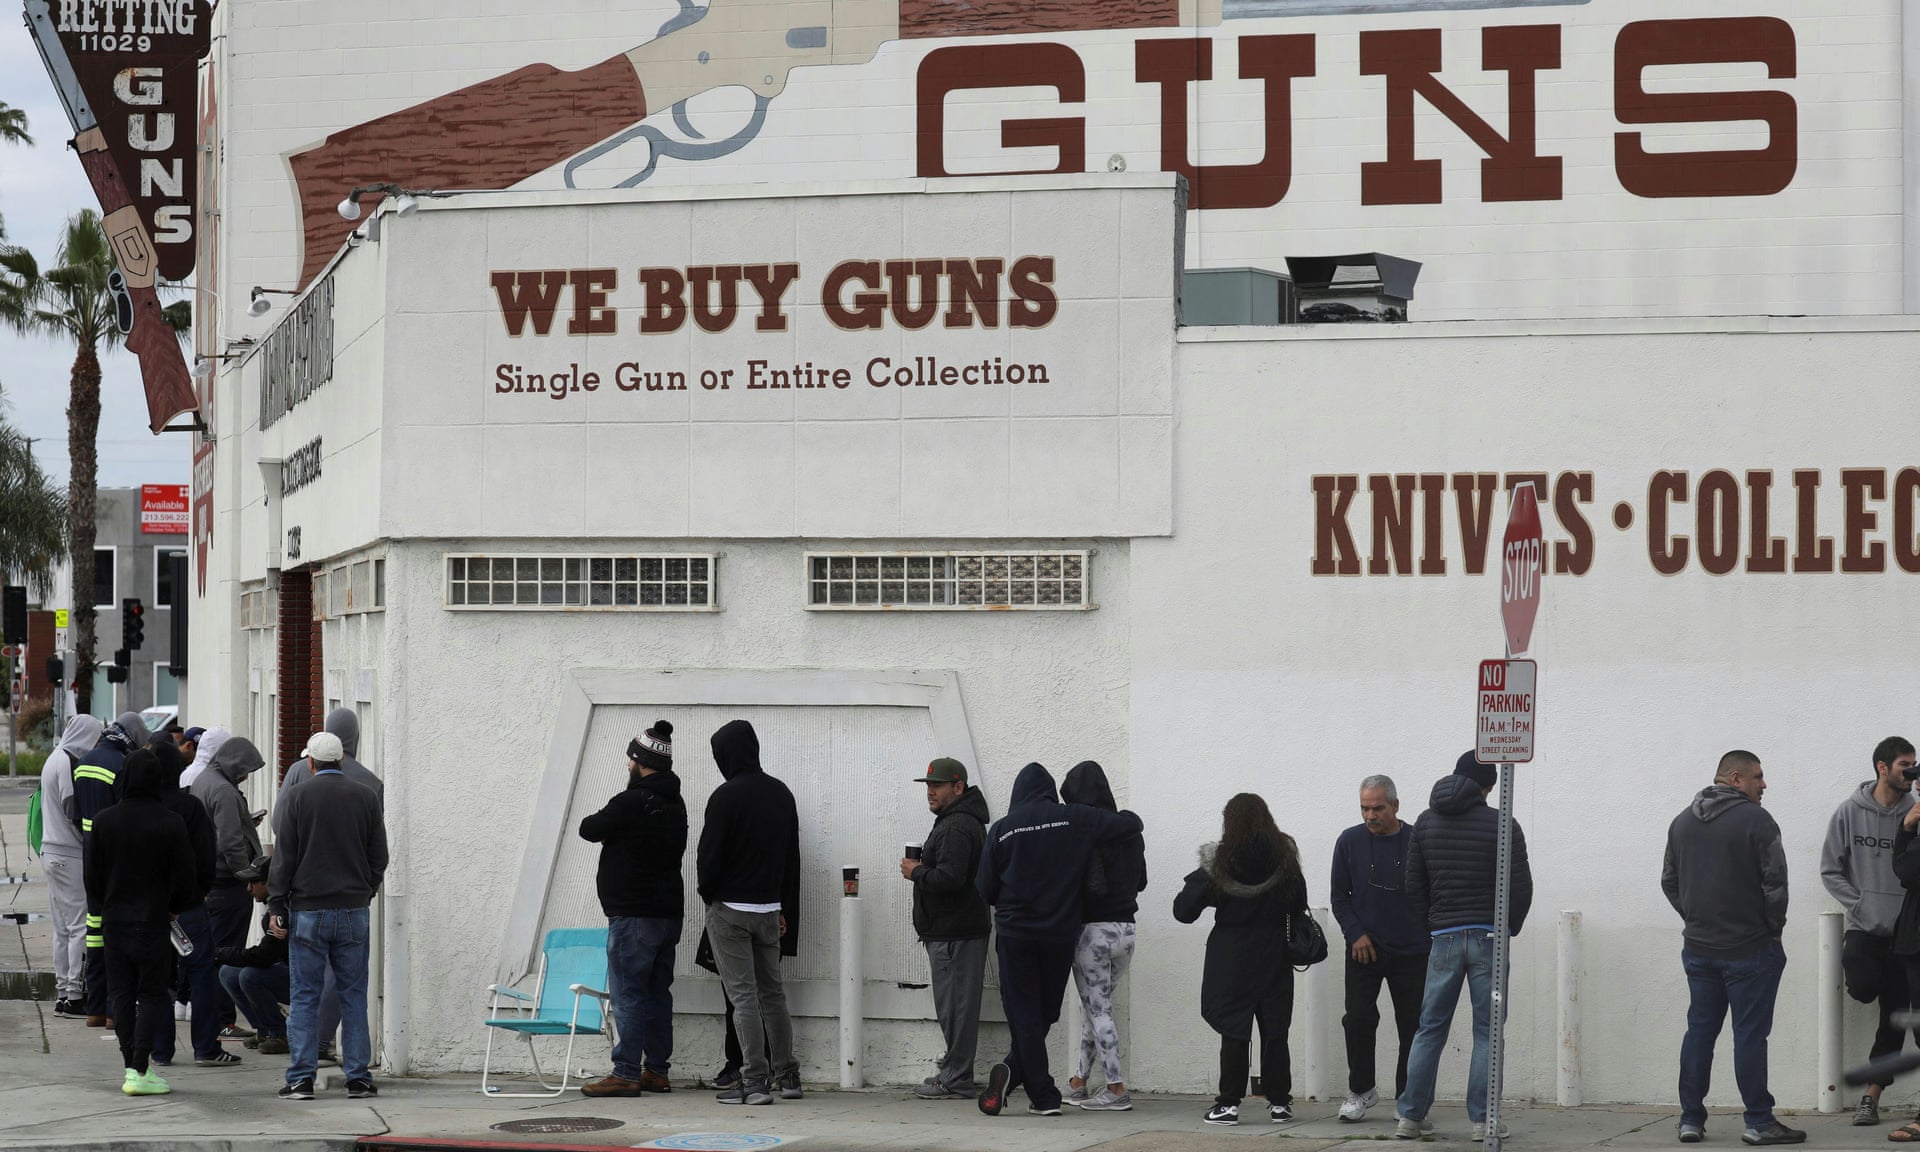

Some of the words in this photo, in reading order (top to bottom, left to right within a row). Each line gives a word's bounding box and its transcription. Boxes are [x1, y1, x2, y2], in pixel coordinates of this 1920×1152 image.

[58, 0, 198, 35] RETTING
[80, 34, 151, 53] 11029
[917, 17, 1798, 210] GUNS
[113, 67, 193, 244] GUNS
[490, 268, 617, 337] WE
[639, 262, 800, 334] BUY
[821, 256, 1058, 331] GUNS
[495, 363, 601, 400] Single
[615, 362, 688, 392] Gun
[699, 369, 735, 391] or
[747, 359, 852, 390] Entire
[866, 357, 1051, 387] Collection
[144, 500, 185, 510] Available
[1503, 538, 1539, 603] STOP
[1483, 664, 1502, 687] NO
[1482, 693, 1531, 713] PARKING
[1481, 746, 1501, 755] STREET
[1502, 746, 1529, 755] CLEANING
[1489, 735, 1522, 744] WEDNESDAY
